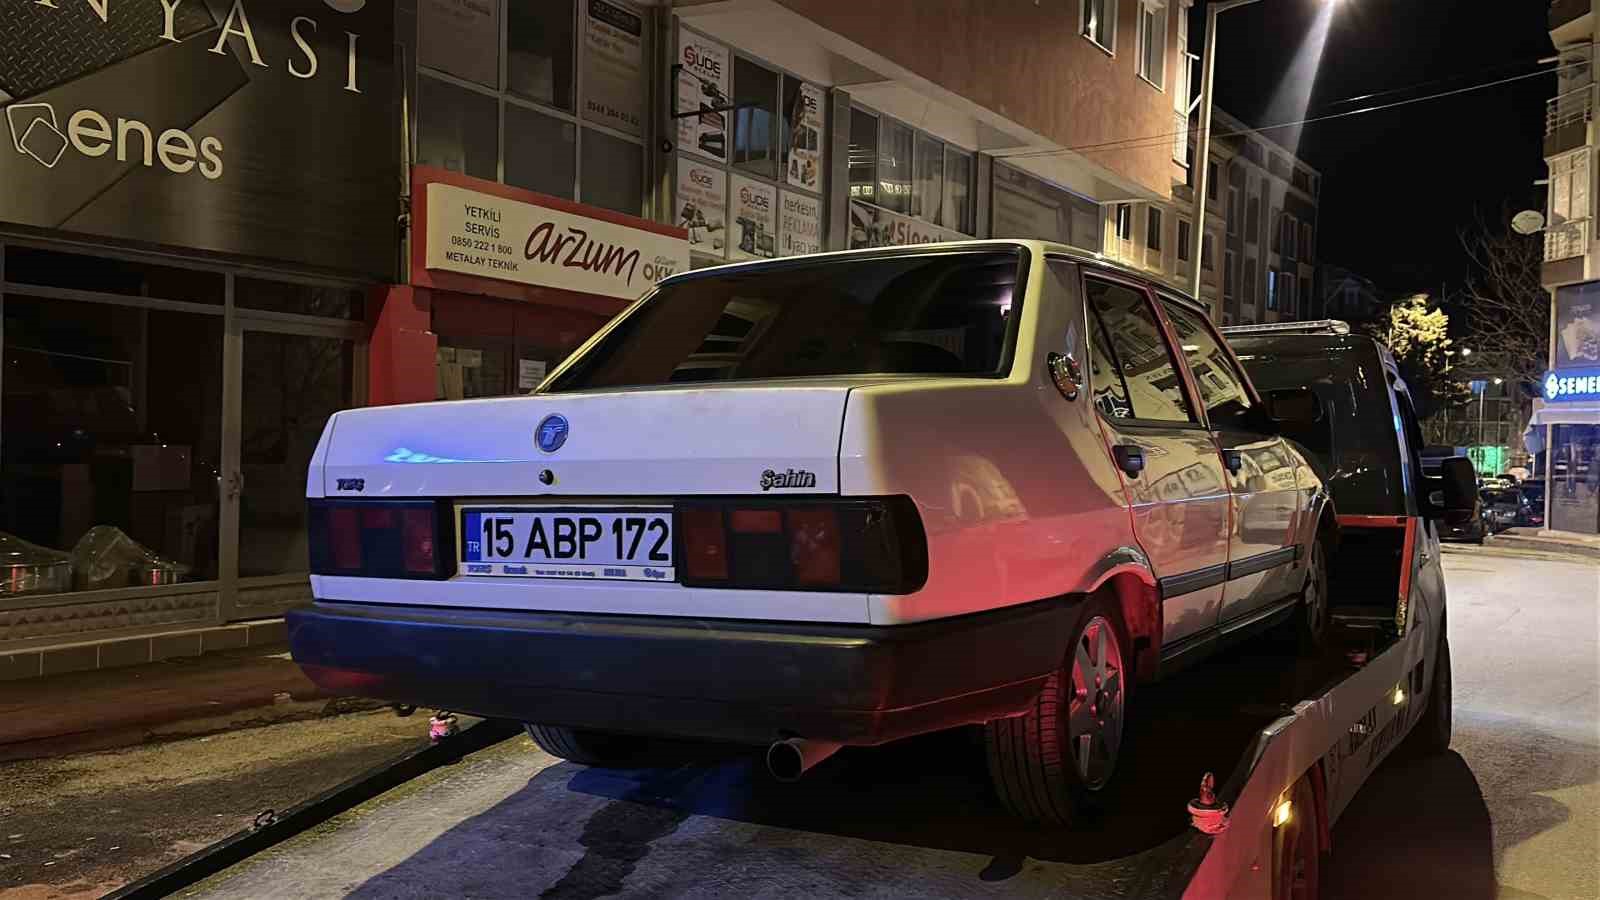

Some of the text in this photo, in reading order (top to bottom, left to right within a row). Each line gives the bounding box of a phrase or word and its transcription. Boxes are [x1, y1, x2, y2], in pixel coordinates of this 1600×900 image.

[67, 109, 224, 180] enes
[464, 204, 502, 224] YETKİLİ
[465, 222, 500, 239] SERVİS
[446, 251, 520, 272] METALAY TEKNİK
[524, 222, 641, 288] arzum
[760, 468, 816, 491] Şahin
[467, 517, 670, 562] TR 15 ABP 172
